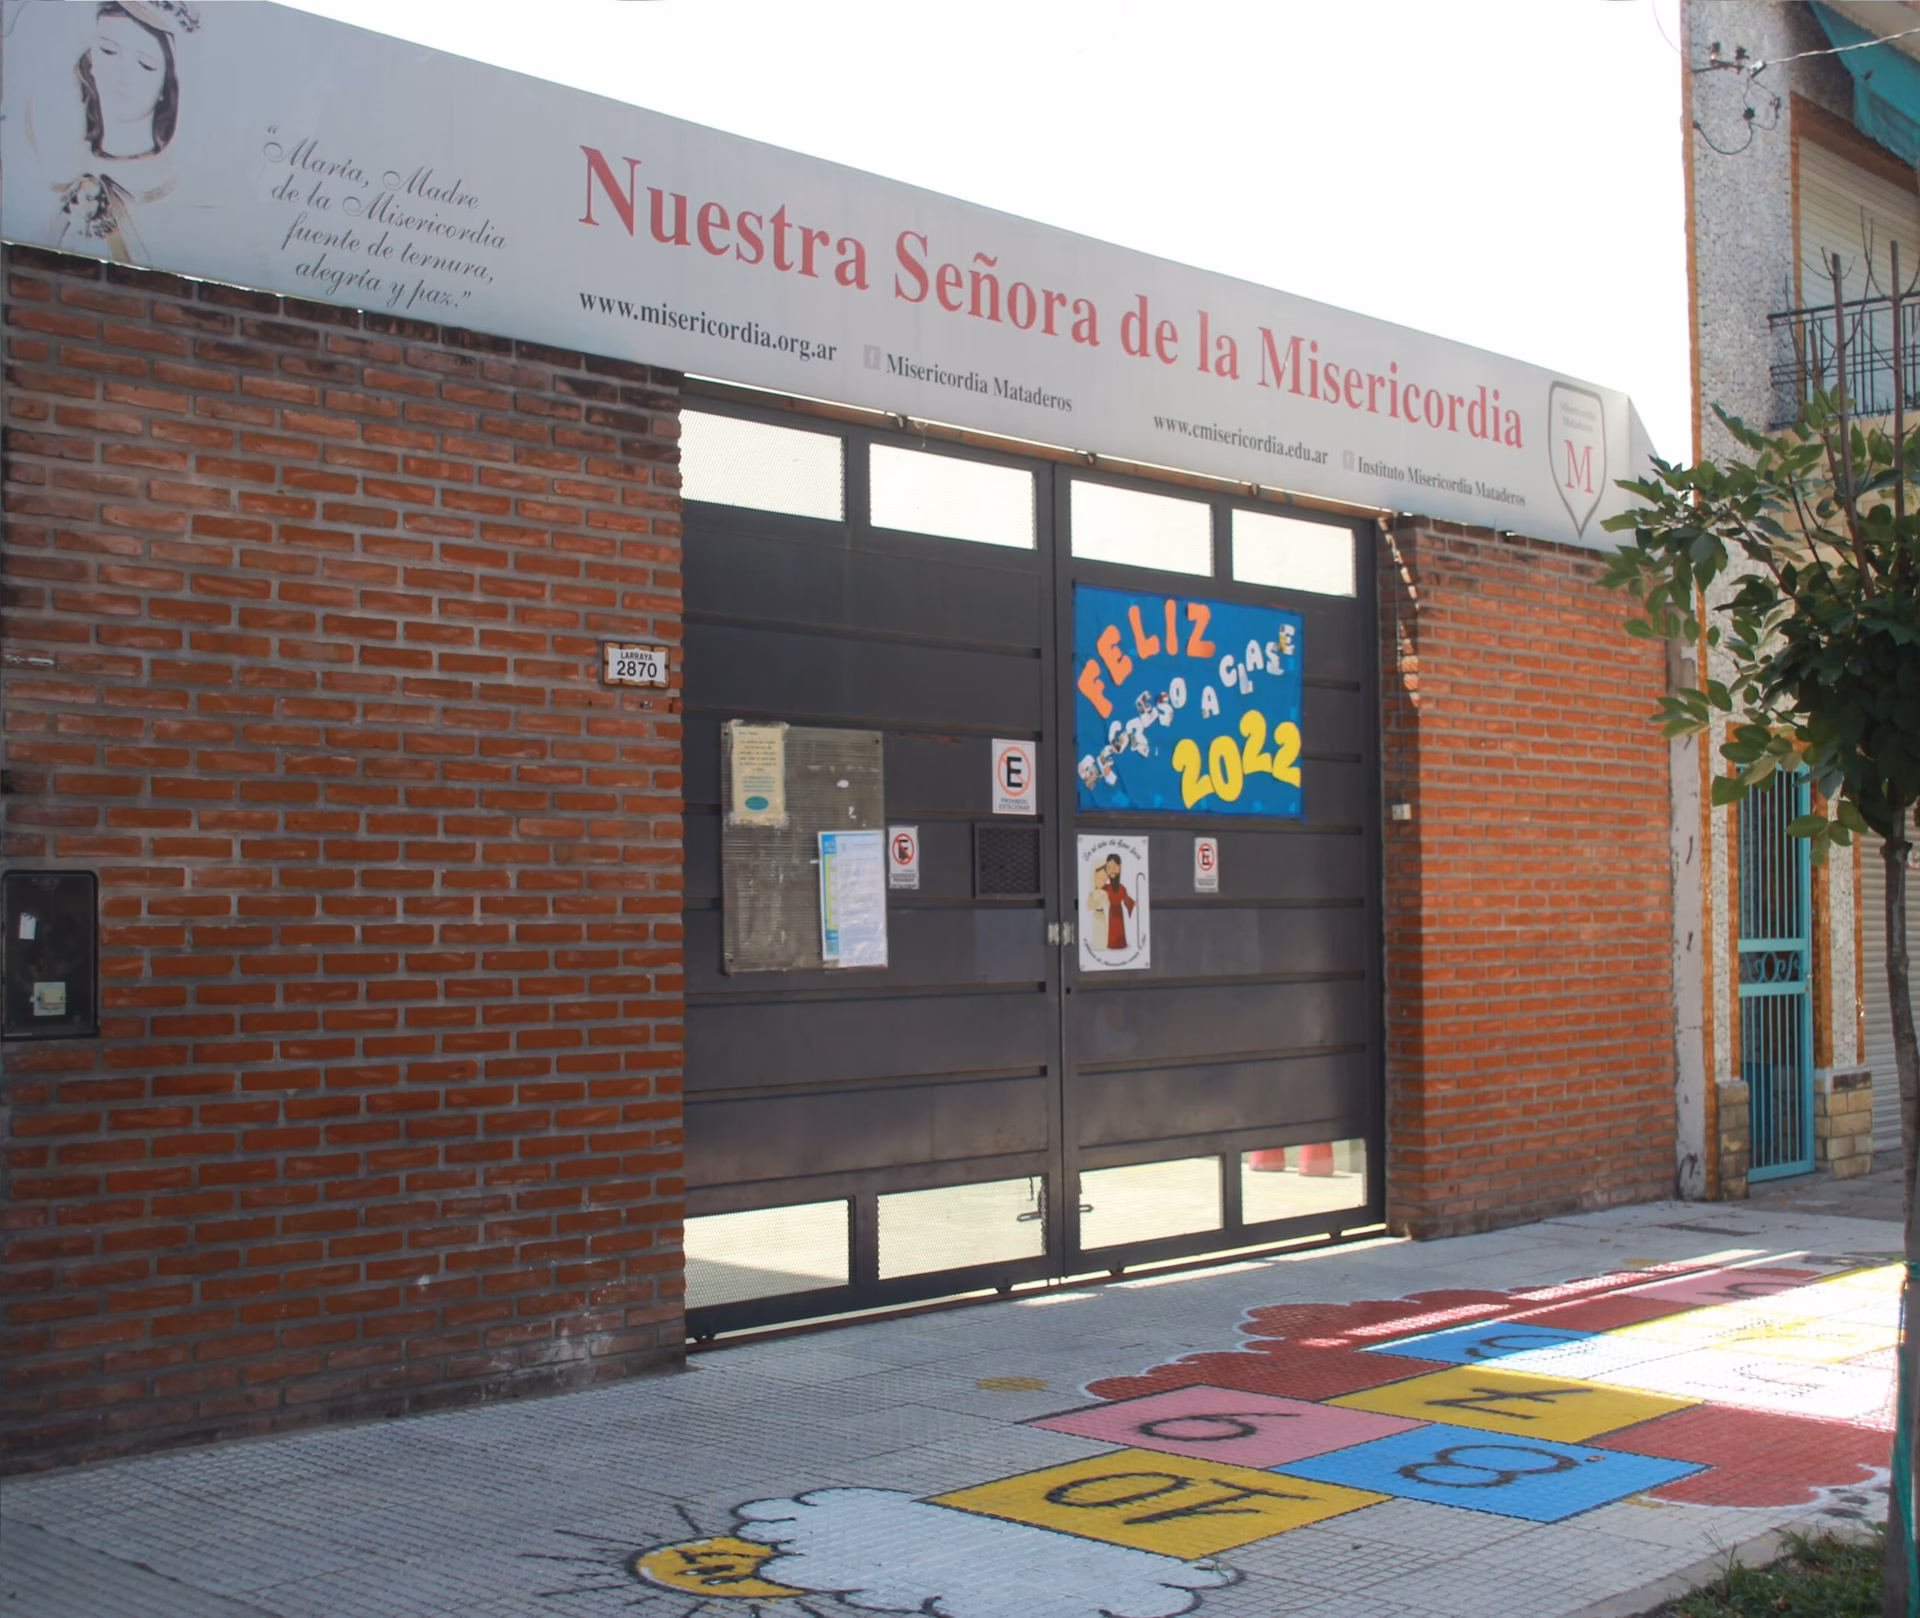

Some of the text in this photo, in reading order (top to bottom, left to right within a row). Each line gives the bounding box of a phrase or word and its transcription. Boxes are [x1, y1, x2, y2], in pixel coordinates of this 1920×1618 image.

[271, 174, 506, 250] de la Misericordia
[382, 166, 479, 209] Madre
[281, 211, 494, 284] fuente de ternura,
[295, 253, 381, 297] alegría
[386, 282, 405, 309] y
[578, 145, 1524, 449] Nuestra Señora de la Misericordia
[579, 292, 838, 361] www.misericordia.org.ar
[886, 353, 1073, 412] Misericordia Mataderos
[1153, 415, 1329, 465] www.cmisericordia.edu.ar
[1564, 439, 1594, 494] M
[1358, 456, 1526, 507] Instituto Misericordia Mataderos
[616, 660, 657, 678] 2870
[620, 651, 653, 661] LARRAYA
[1078, 599, 1216, 719] FELIZ
[1201, 685, 1220, 719] A
[1219, 624, 1295, 695] CLASE
[1006, 756, 1022, 788] E
[1172, 710, 1301, 809] 2022
[1396, 1444, 1581, 1488] 8
